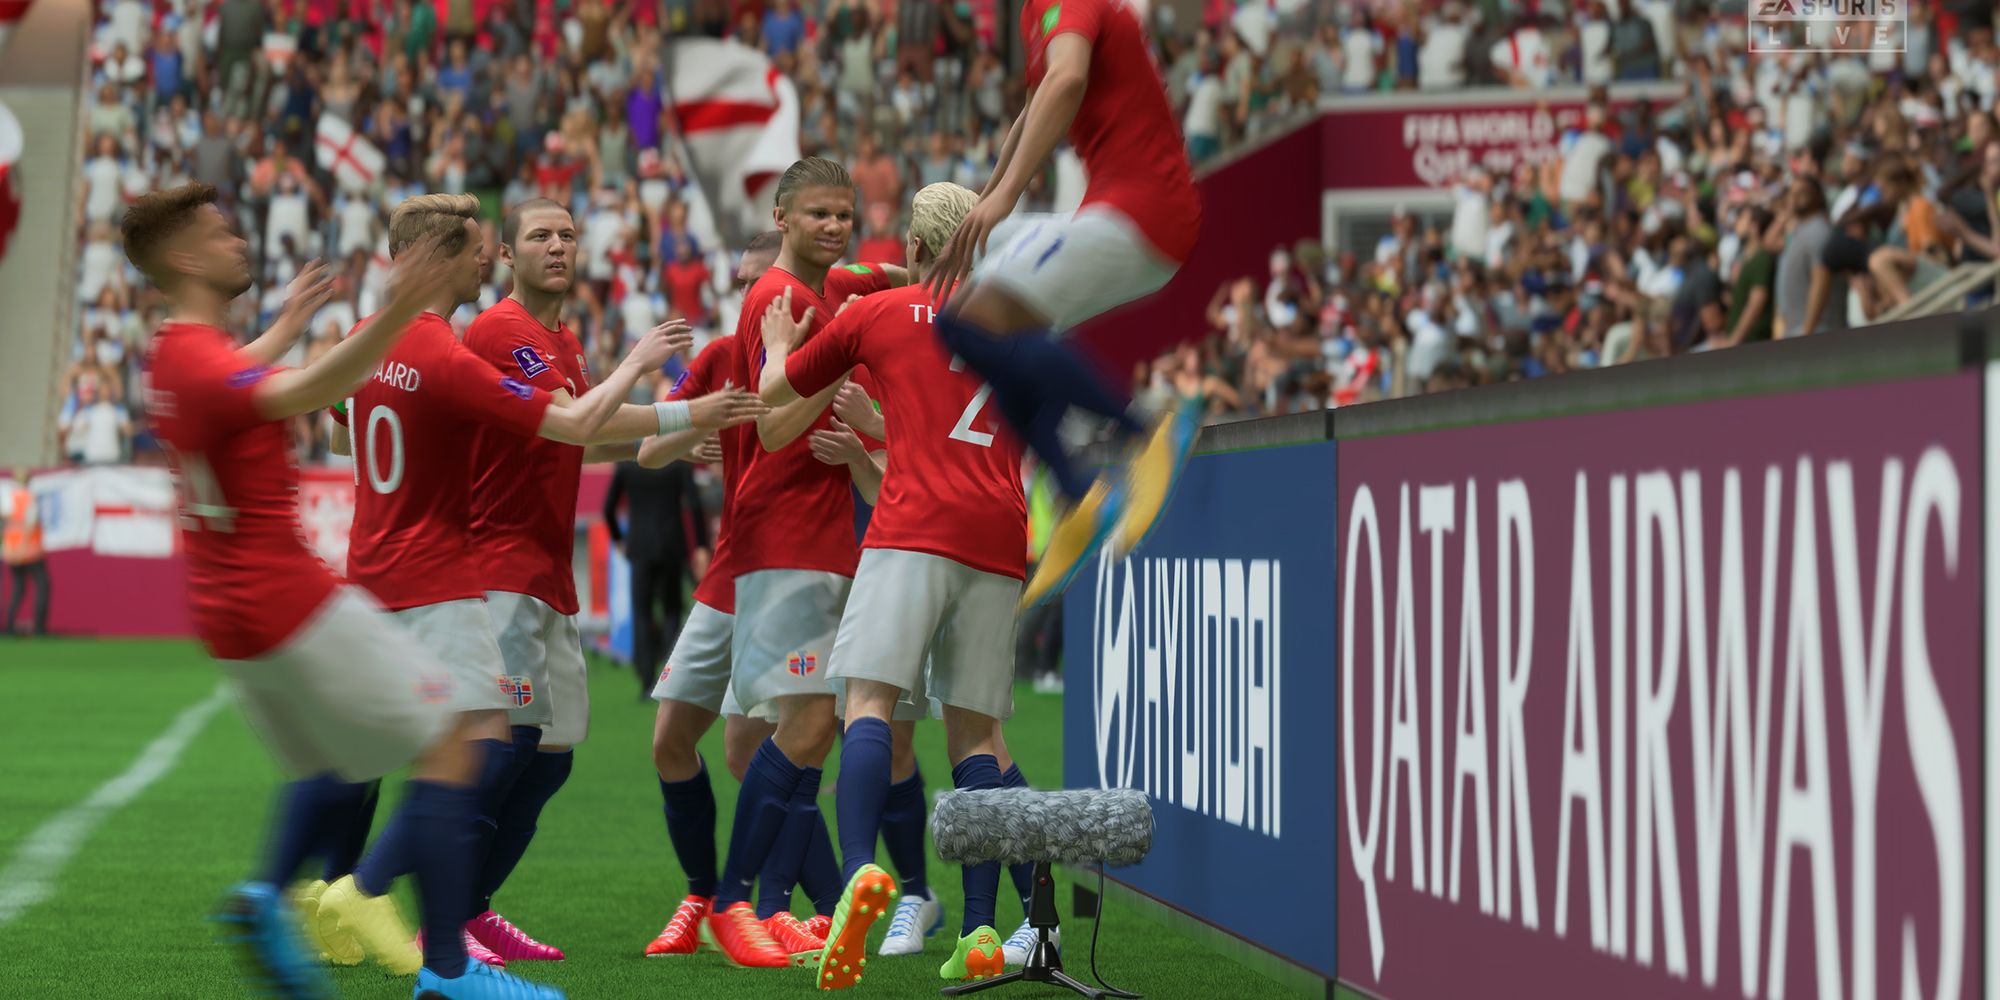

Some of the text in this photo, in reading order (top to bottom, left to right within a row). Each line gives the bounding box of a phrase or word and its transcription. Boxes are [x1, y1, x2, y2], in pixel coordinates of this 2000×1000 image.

[1402, 113, 1458, 148] FIFA
[1459, 110, 1554, 146] WORLD
[373, 359, 420, 392] AARD
[345, 397, 405, 494] 10
[1144, 557, 1280, 839] HYUNDAI
[1343, 445, 1966, 1000] QATAR AIRWAYS
[977, 933, 996, 945] EA
